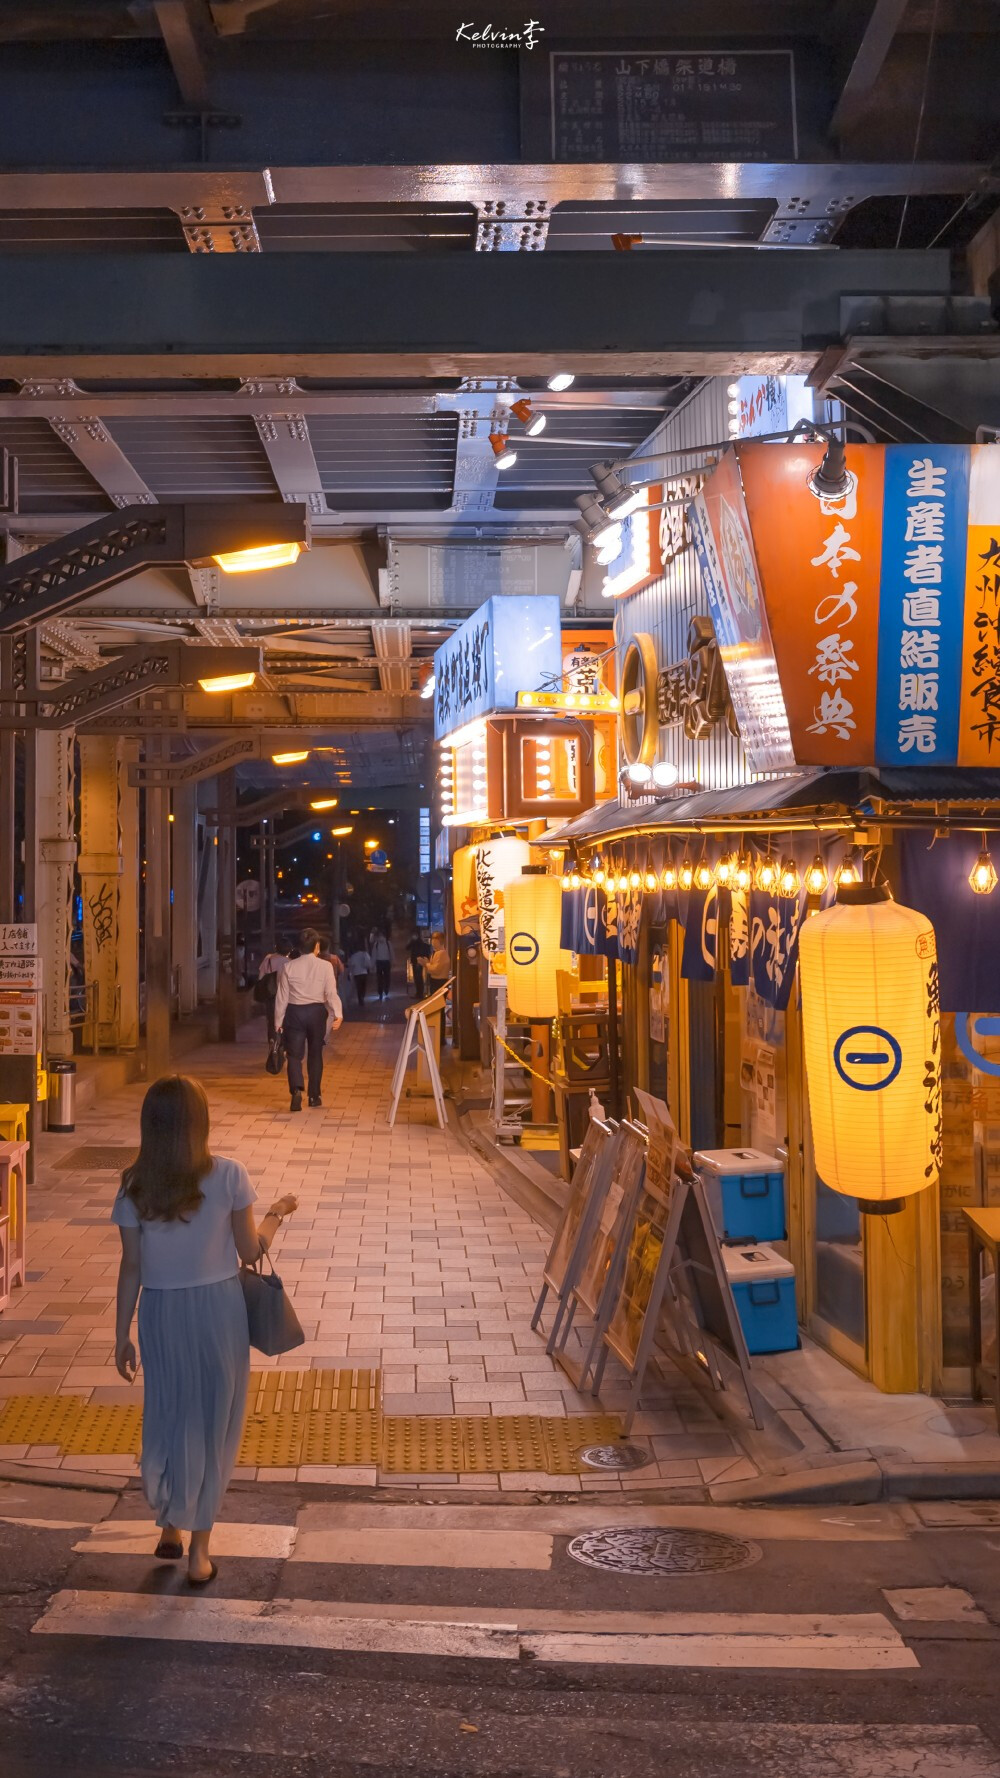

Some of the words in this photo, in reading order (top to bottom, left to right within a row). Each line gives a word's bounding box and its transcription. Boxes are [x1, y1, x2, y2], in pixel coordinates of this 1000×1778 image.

[807, 470, 861, 740] 日本の祭典
[898, 458, 948, 753] 生産者直結販売
[476, 848, 499, 952] 北海道食市
